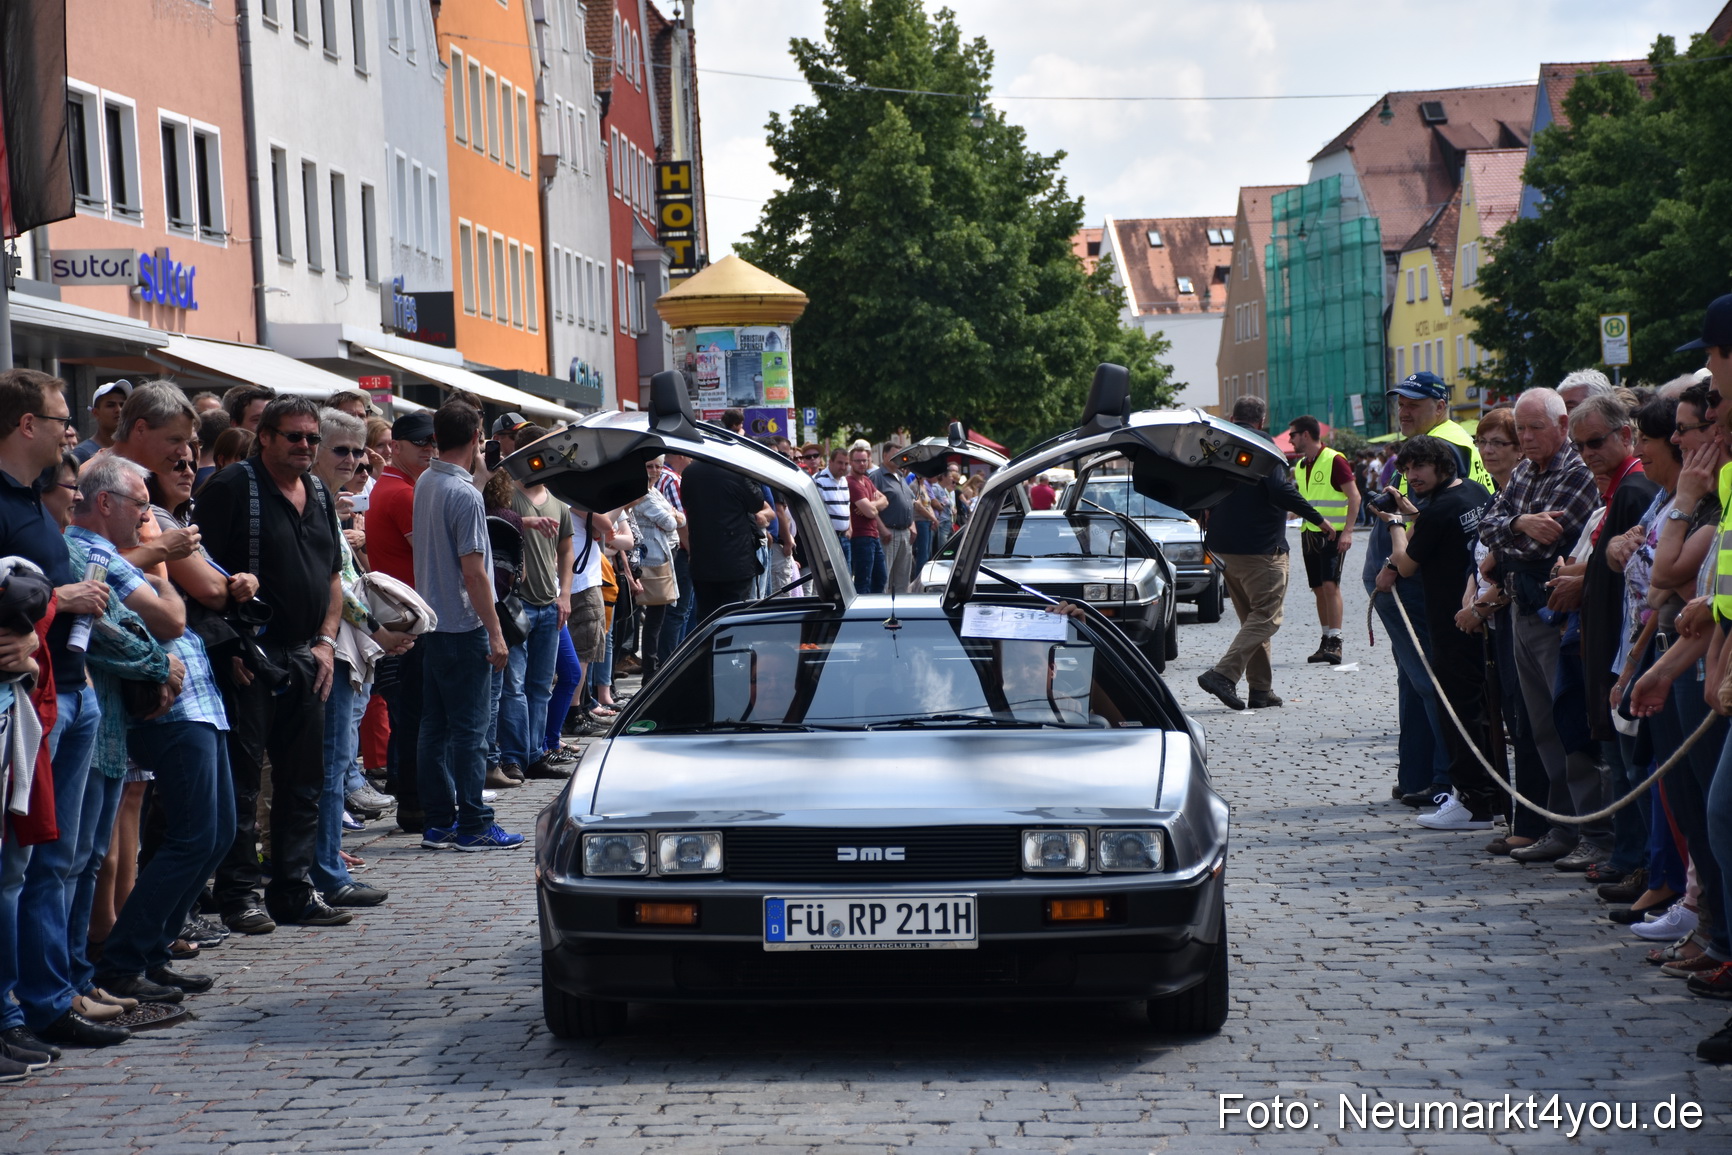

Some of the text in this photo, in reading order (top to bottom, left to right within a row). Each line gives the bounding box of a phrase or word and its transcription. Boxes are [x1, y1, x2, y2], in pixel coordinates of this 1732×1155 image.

[661, 165, 693, 265] HOT
[53, 254, 132, 278] sutor.
[138, 247, 199, 311] sutor.
[1415, 320, 1430, 337] HOTEL
[1610, 322, 1620, 334] H
[740, 334, 765, 343] CHRISTIAN
[806, 410, 814, 425] P
[1013, 611, 1050, 621] 312
[787, 902, 972, 937] FÜ RP 211H
[771, 924, 779, 935] D
